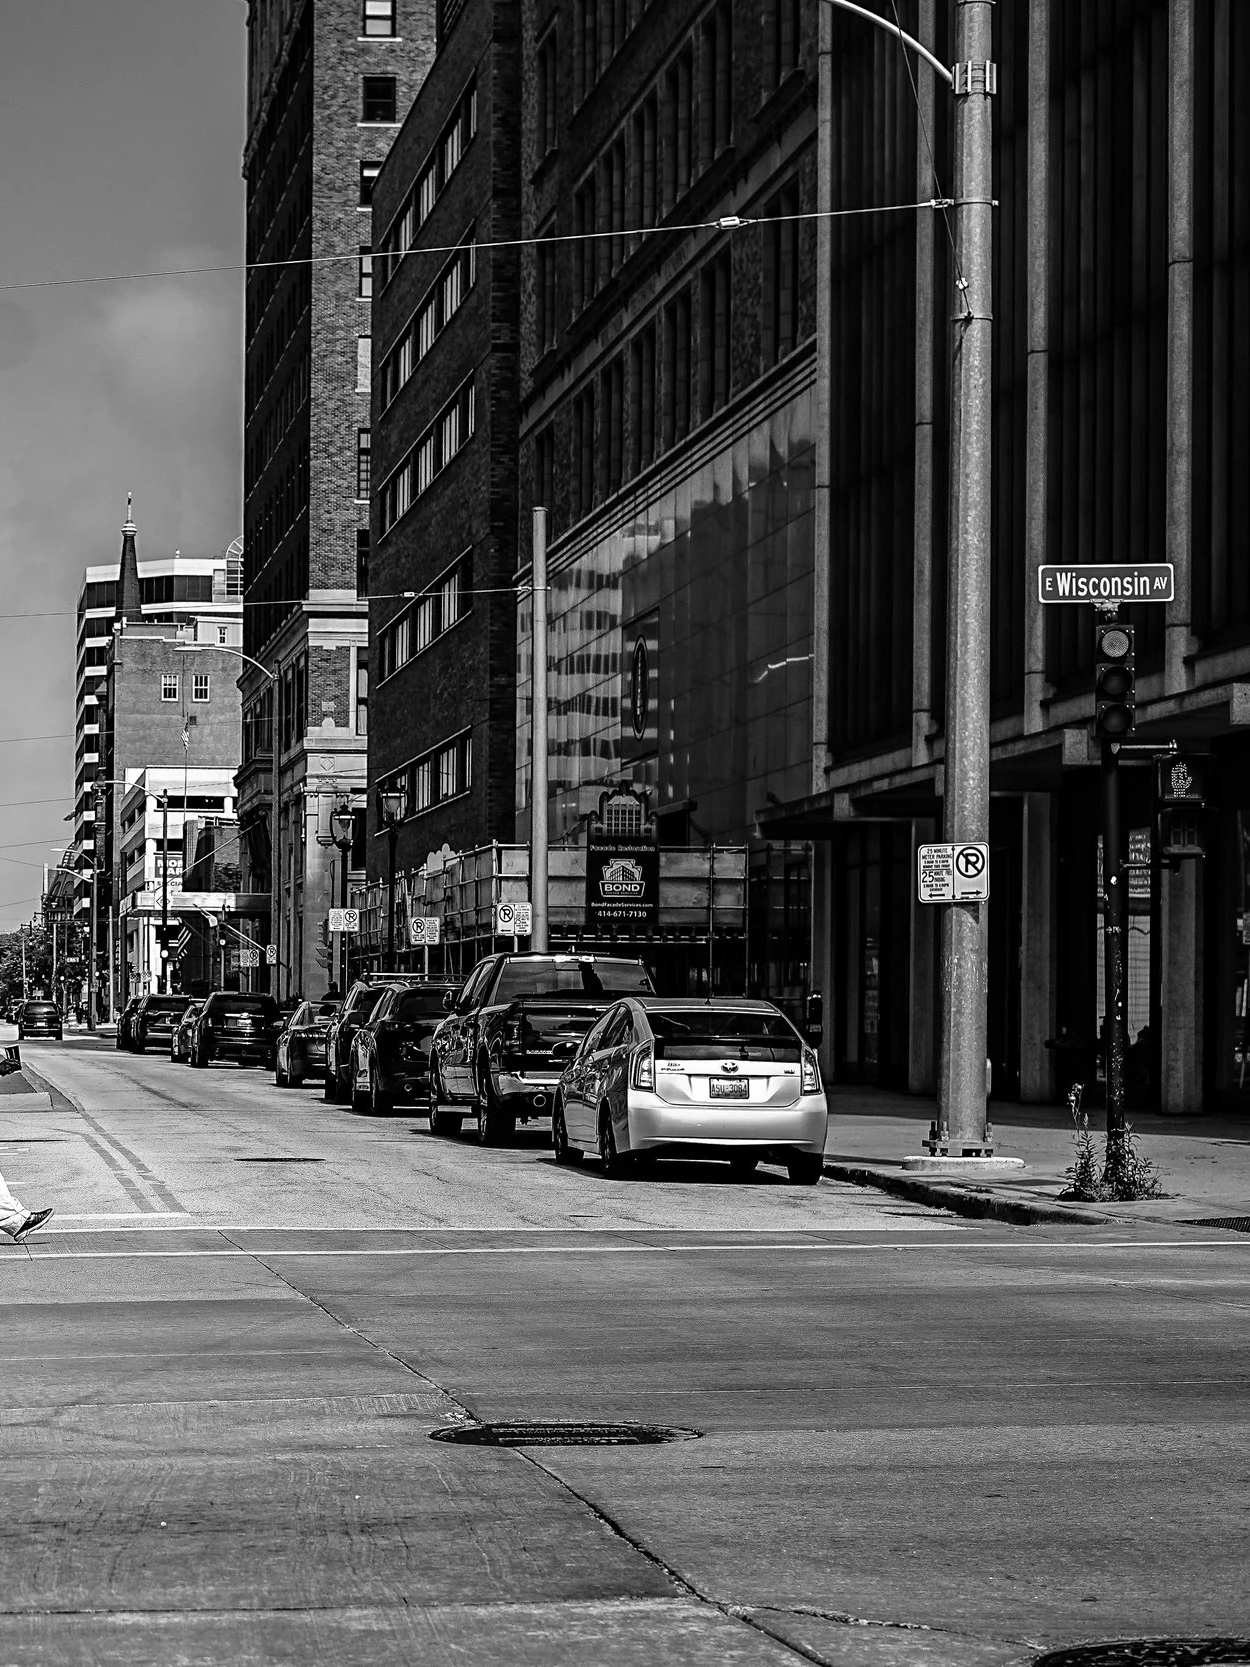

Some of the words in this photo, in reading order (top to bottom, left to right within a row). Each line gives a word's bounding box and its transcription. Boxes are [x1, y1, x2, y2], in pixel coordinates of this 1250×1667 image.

[1046, 578, 1053, 590] E
[1056, 571, 1150, 596] Wisconsin
[1153, 577, 1167, 590] AV
[922, 871, 934, 883] 25
[604, 884, 640, 892] BOND
